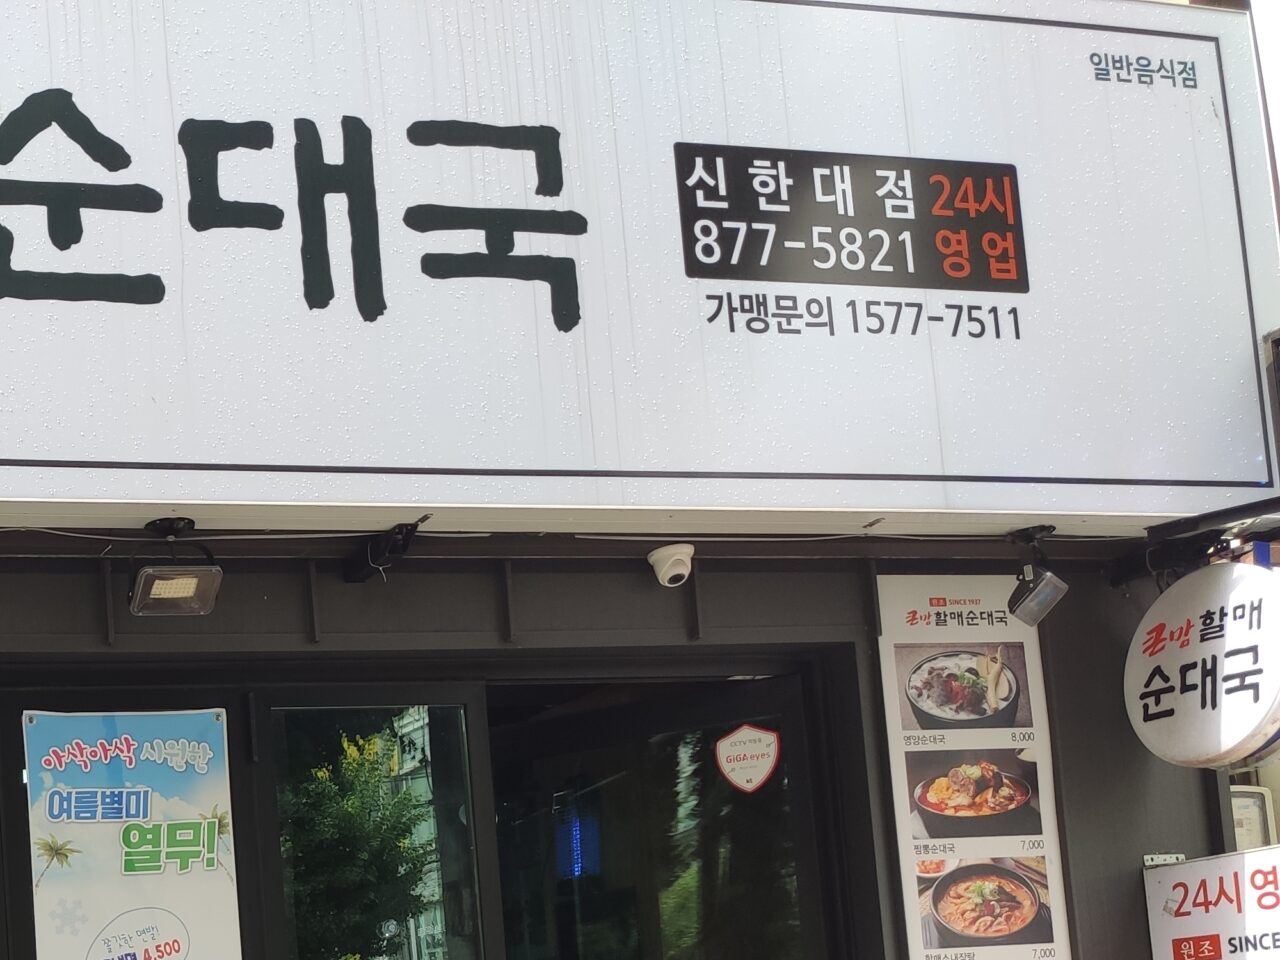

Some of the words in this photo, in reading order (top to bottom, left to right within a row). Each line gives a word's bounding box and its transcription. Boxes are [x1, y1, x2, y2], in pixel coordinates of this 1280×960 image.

[1088, 52, 1198, 89] 일반음식점
[929, 174, 1015, 225] 24시
[694, 220, 916, 273] 877-5821
[705, 292, 836, 337] 가맹문의
[846, 299, 1021, 340] 1577-7511
[934, 610, 1008, 627] 할매순대국
[1142, 618, 1195, 658] 큰맘
[1199, 598, 1263, 643] 할매
[1139, 644, 1264, 723] 순대국
[41, 735, 138, 772] 아삭아삭
[140, 738, 214, 774] 시원한
[1011, 732, 1035, 743] 8,000
[46, 787, 152, 823] 여름별미
[120, 818, 219, 875] 열무!
[1020, 840, 1045, 851] 7,000
[1172, 871, 1243, 918] 24시
[1032, 948, 1056, 960] 7,000
[1180, 940, 1216, 960] 원조
